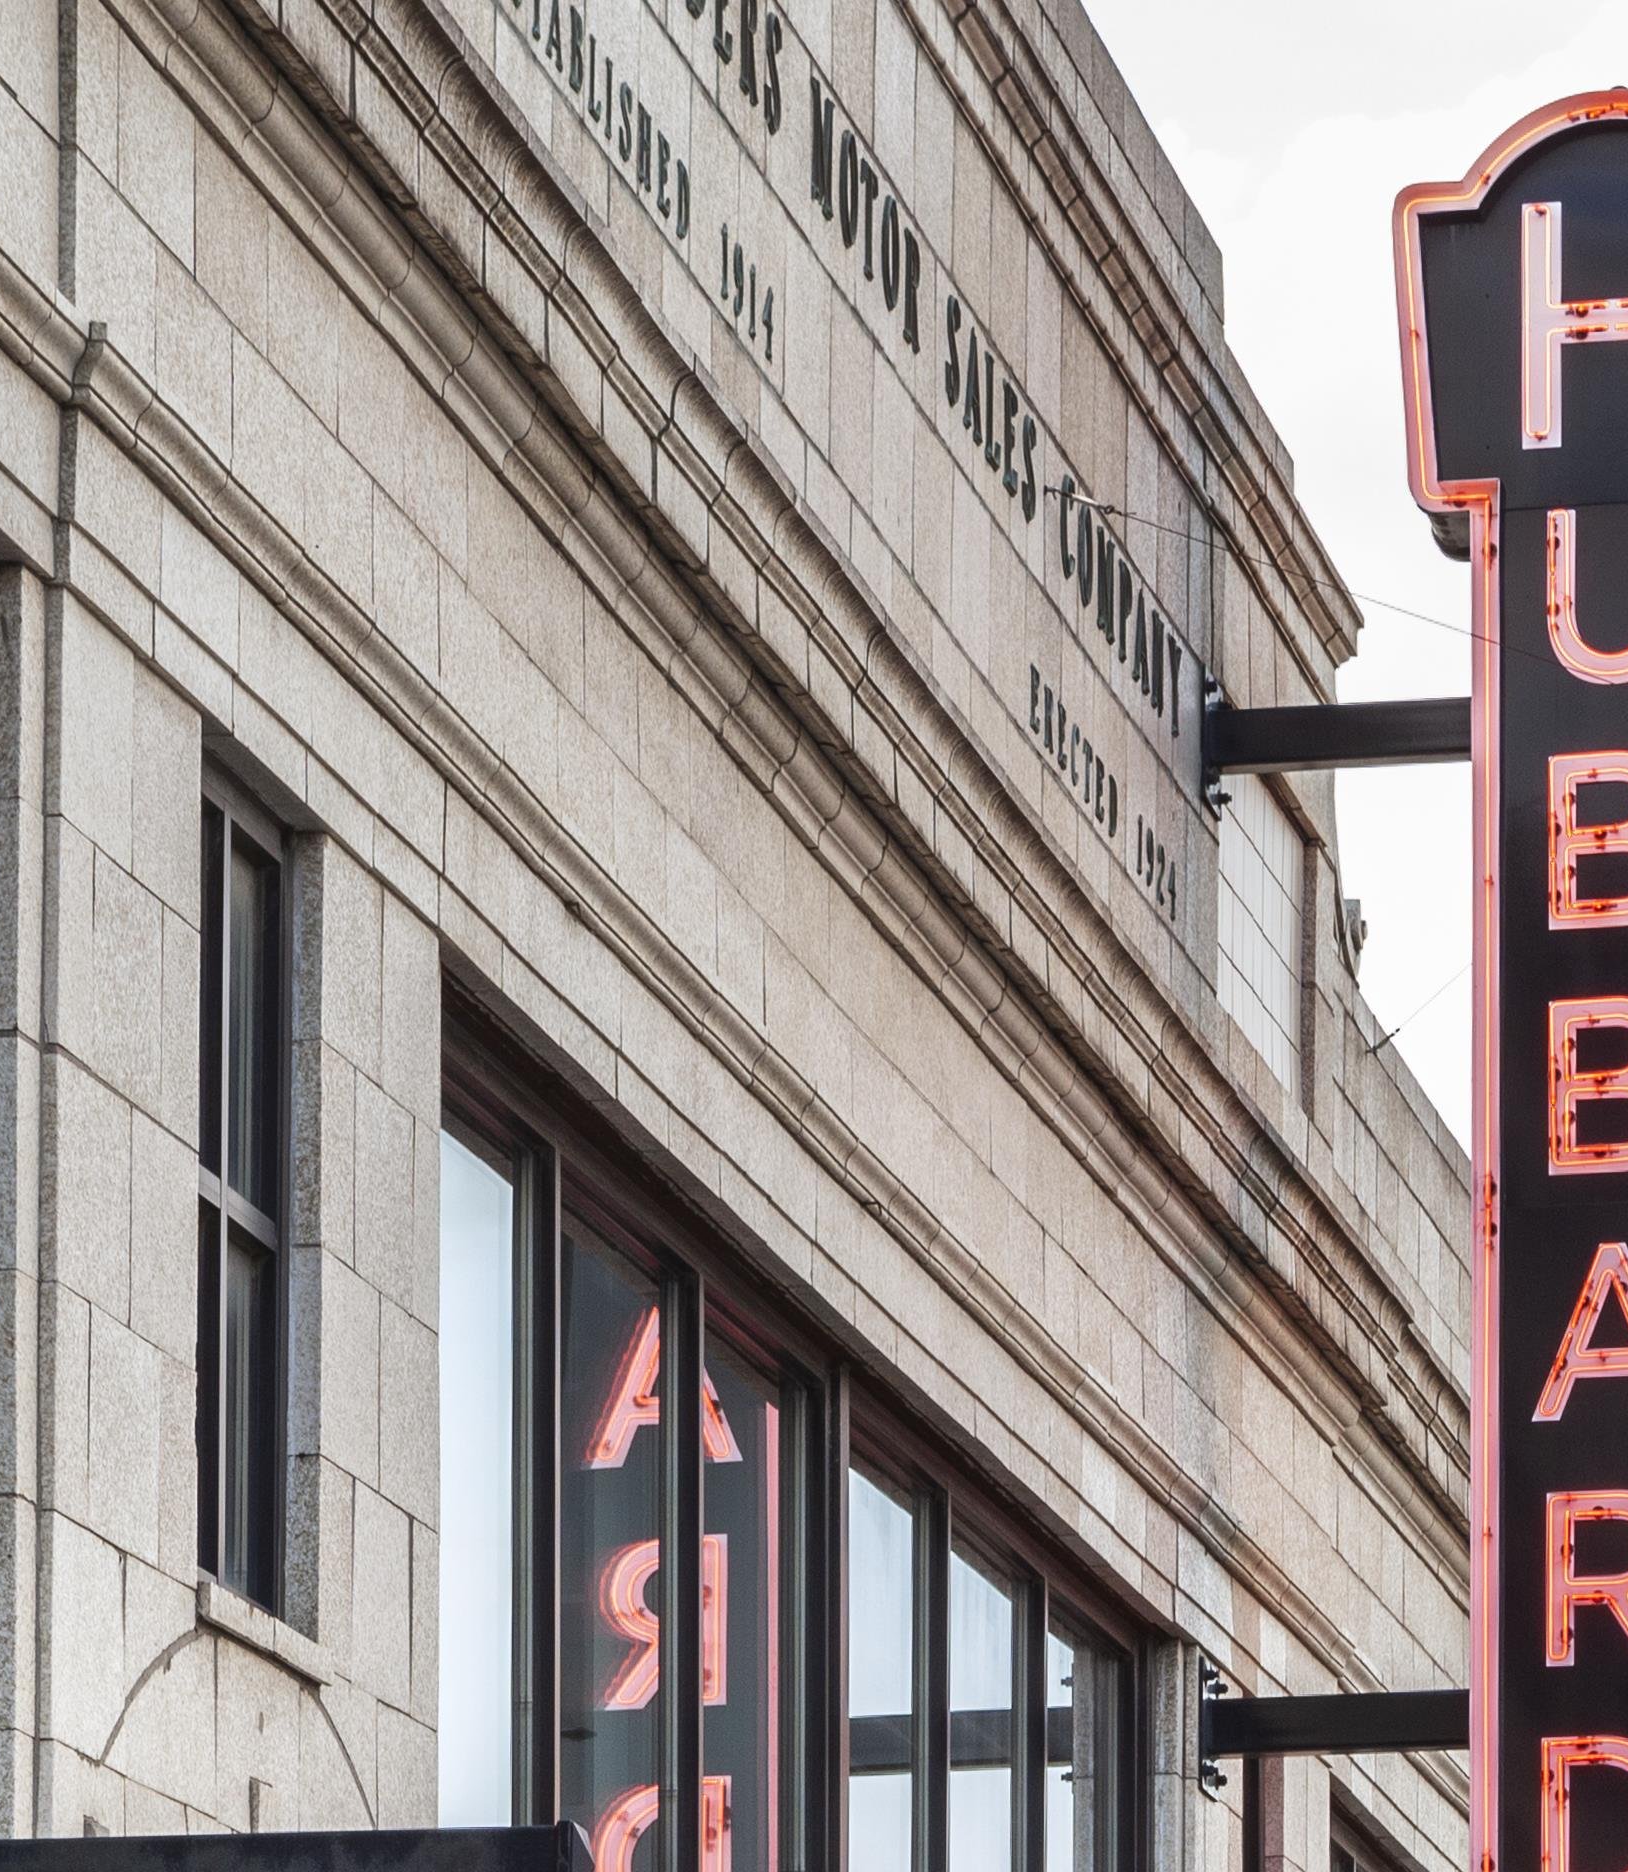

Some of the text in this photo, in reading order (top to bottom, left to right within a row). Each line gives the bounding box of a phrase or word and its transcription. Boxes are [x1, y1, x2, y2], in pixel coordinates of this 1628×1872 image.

[721, 222, 773, 361] 1914
[810, 76, 920, 355] MOTOR
[945, 294, 1037, 524] SALES
[1059, 474, 1183, 738] COMPANY
[1029, 662, 1177, 922] ERECTED 1924
